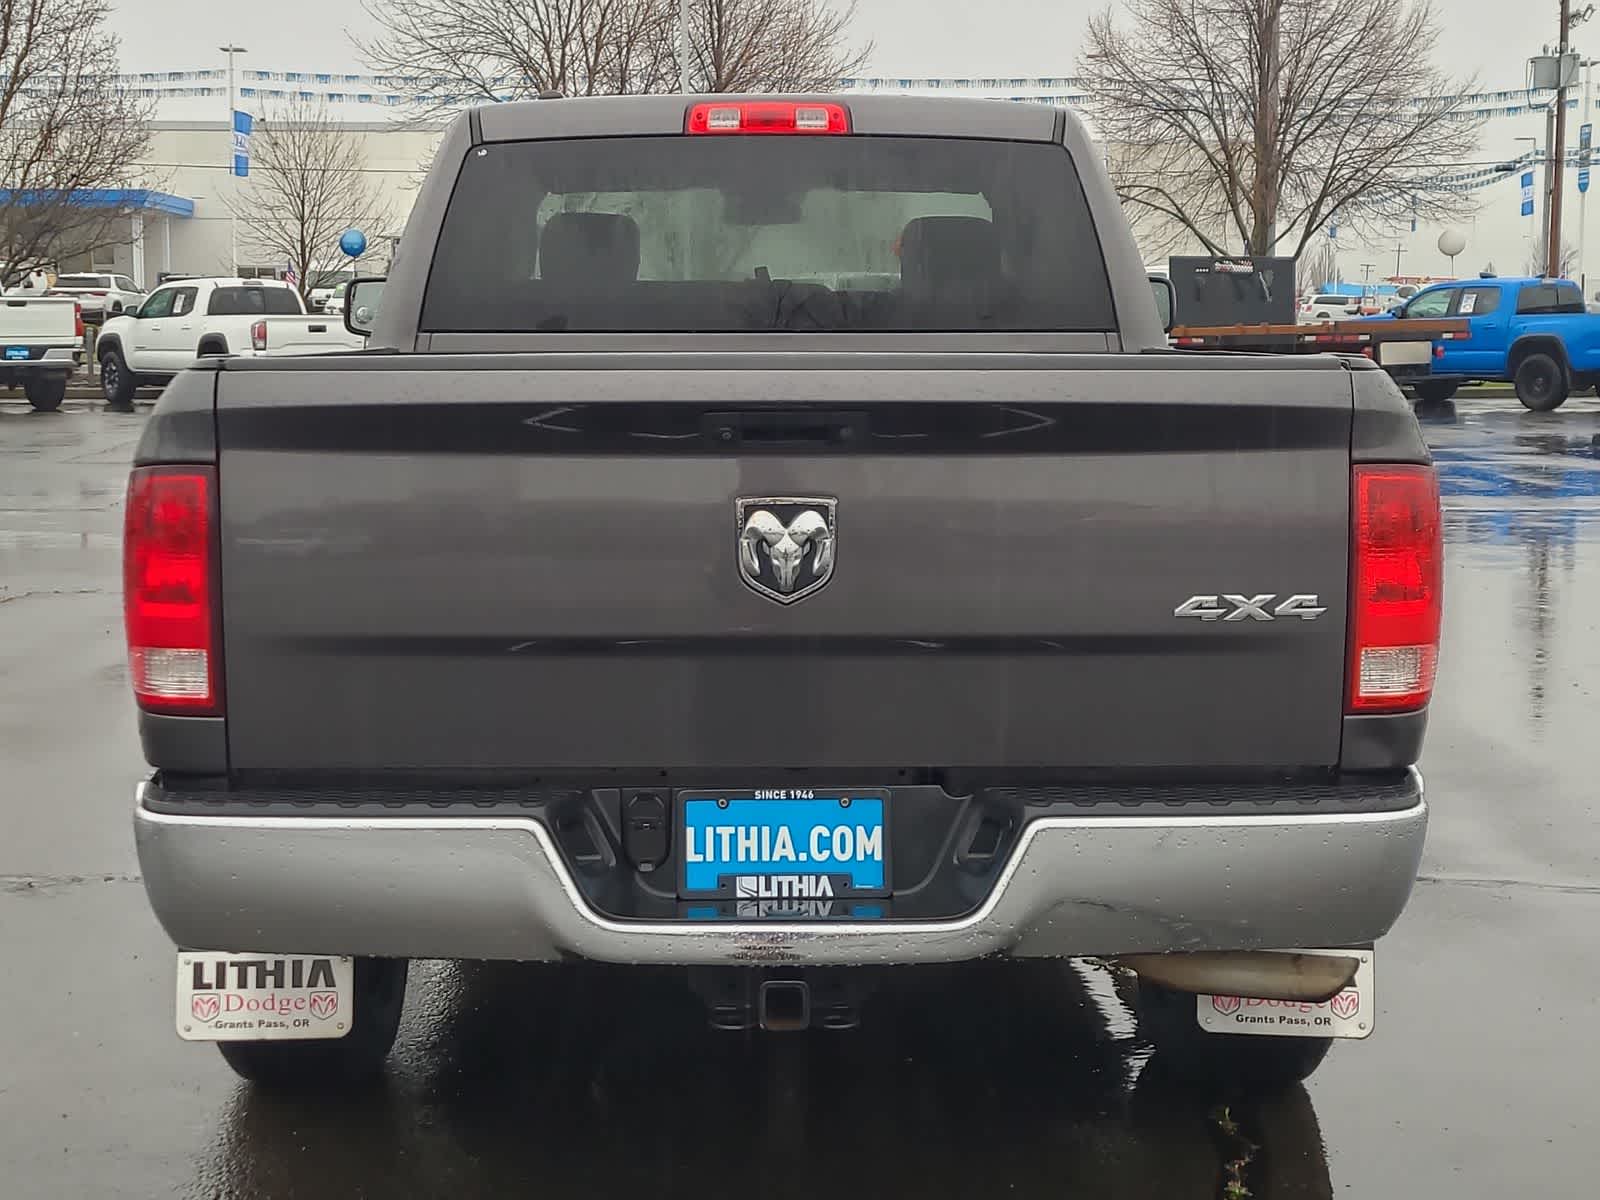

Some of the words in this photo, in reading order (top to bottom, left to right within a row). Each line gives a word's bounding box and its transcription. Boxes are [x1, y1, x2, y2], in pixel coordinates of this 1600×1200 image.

[754, 790, 787, 800] SINCE
[789, 790, 814, 800] 1946
[685, 825, 882, 862] LITHIA.COM
[758, 875, 834, 898] LITHIA
[192, 959, 337, 990] LITHIA
[223, 993, 306, 1016] Dodge
[214, 1020, 254, 1030] Grants
[257, 1019, 289, 1029] Pass,
[292, 1018, 310, 1028] OR
[1235, 1013, 1275, 1024] Grants
[1279, 1015, 1311, 1026] Pass,
[1314, 1017, 1332, 1026] OR
